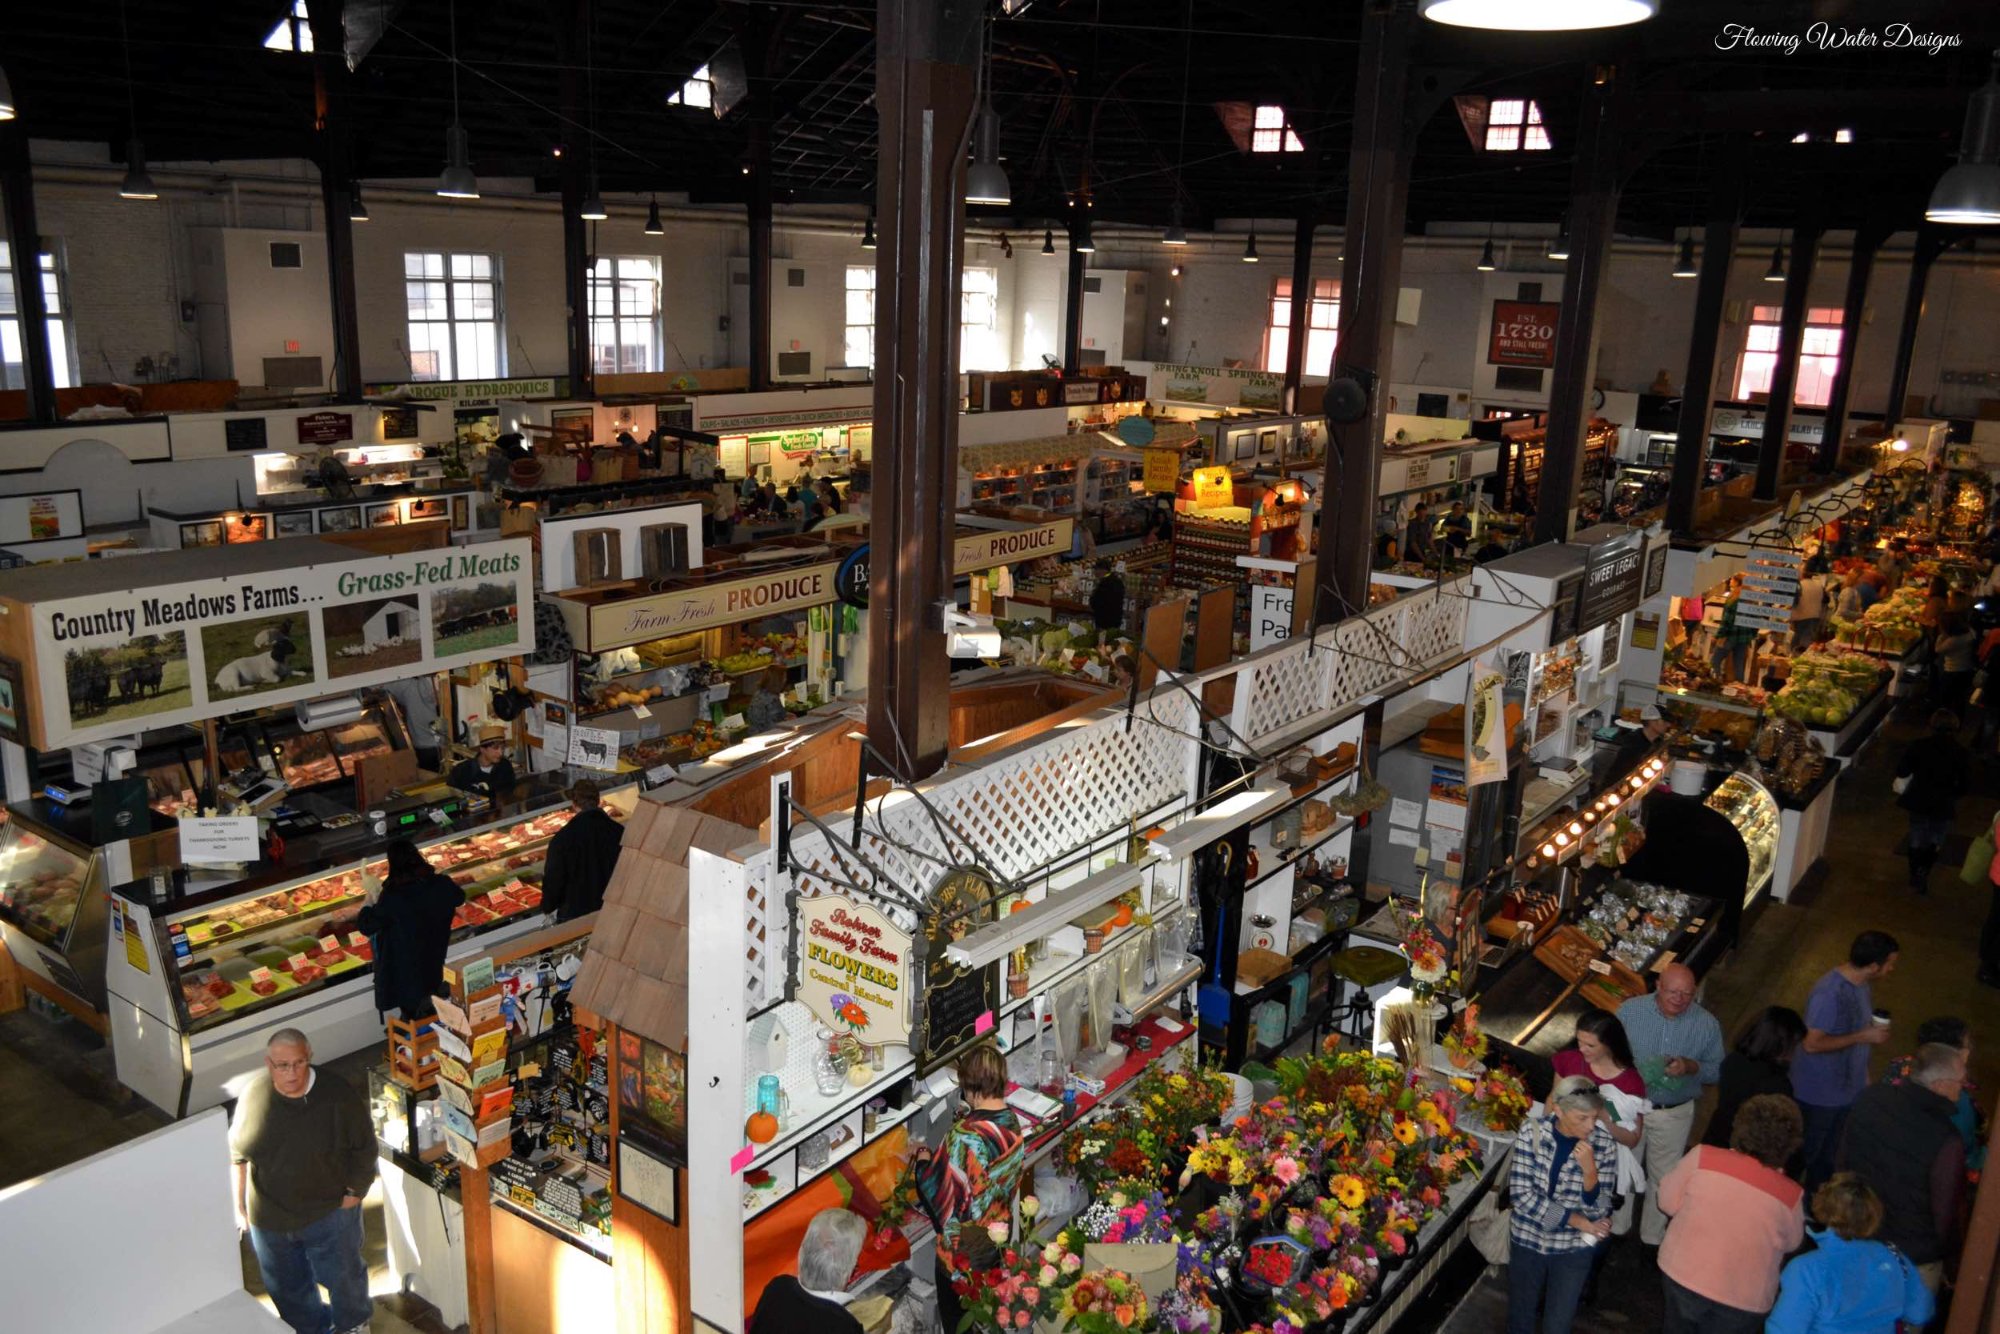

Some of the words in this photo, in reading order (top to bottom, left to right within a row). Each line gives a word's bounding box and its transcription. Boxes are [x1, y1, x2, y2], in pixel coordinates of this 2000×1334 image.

[1496, 321, 1554, 341] 1730
[1153, 363, 1189, 374] SPRING
[1191, 365, 1222, 378] KNOLL
[1174, 372, 1202, 381] FARM
[1228, 369, 1264, 380] SPRING
[1248, 378, 1277, 387] FARM
[465, 381, 550, 398] HYDROPONICS
[1201, 489, 1229, 499] Recipes
[990, 528, 1056, 558] PRODUCE
[337, 556, 453, 597] Grass-Fed
[458, 552, 521, 578] Meats
[1589, 563, 1615, 587] SWEET
[1615, 553, 1641, 577] LEGACY
[51, 607, 136, 641] Country
[141, 593, 236, 627] Meadows
[624, 608, 672, 633] Farm
[673, 598, 717, 621] Fresh
[727, 573, 822, 613] PRODUCE
[830, 908, 883, 939] Rohrer
[809, 918, 858, 953] Family
[859, 937, 899, 965] Farm
[808, 941, 899, 991] FLOWERS
[846, 973, 857, 983] at
[809, 967, 850, 992] Central
[853, 984, 894, 1010] Market
